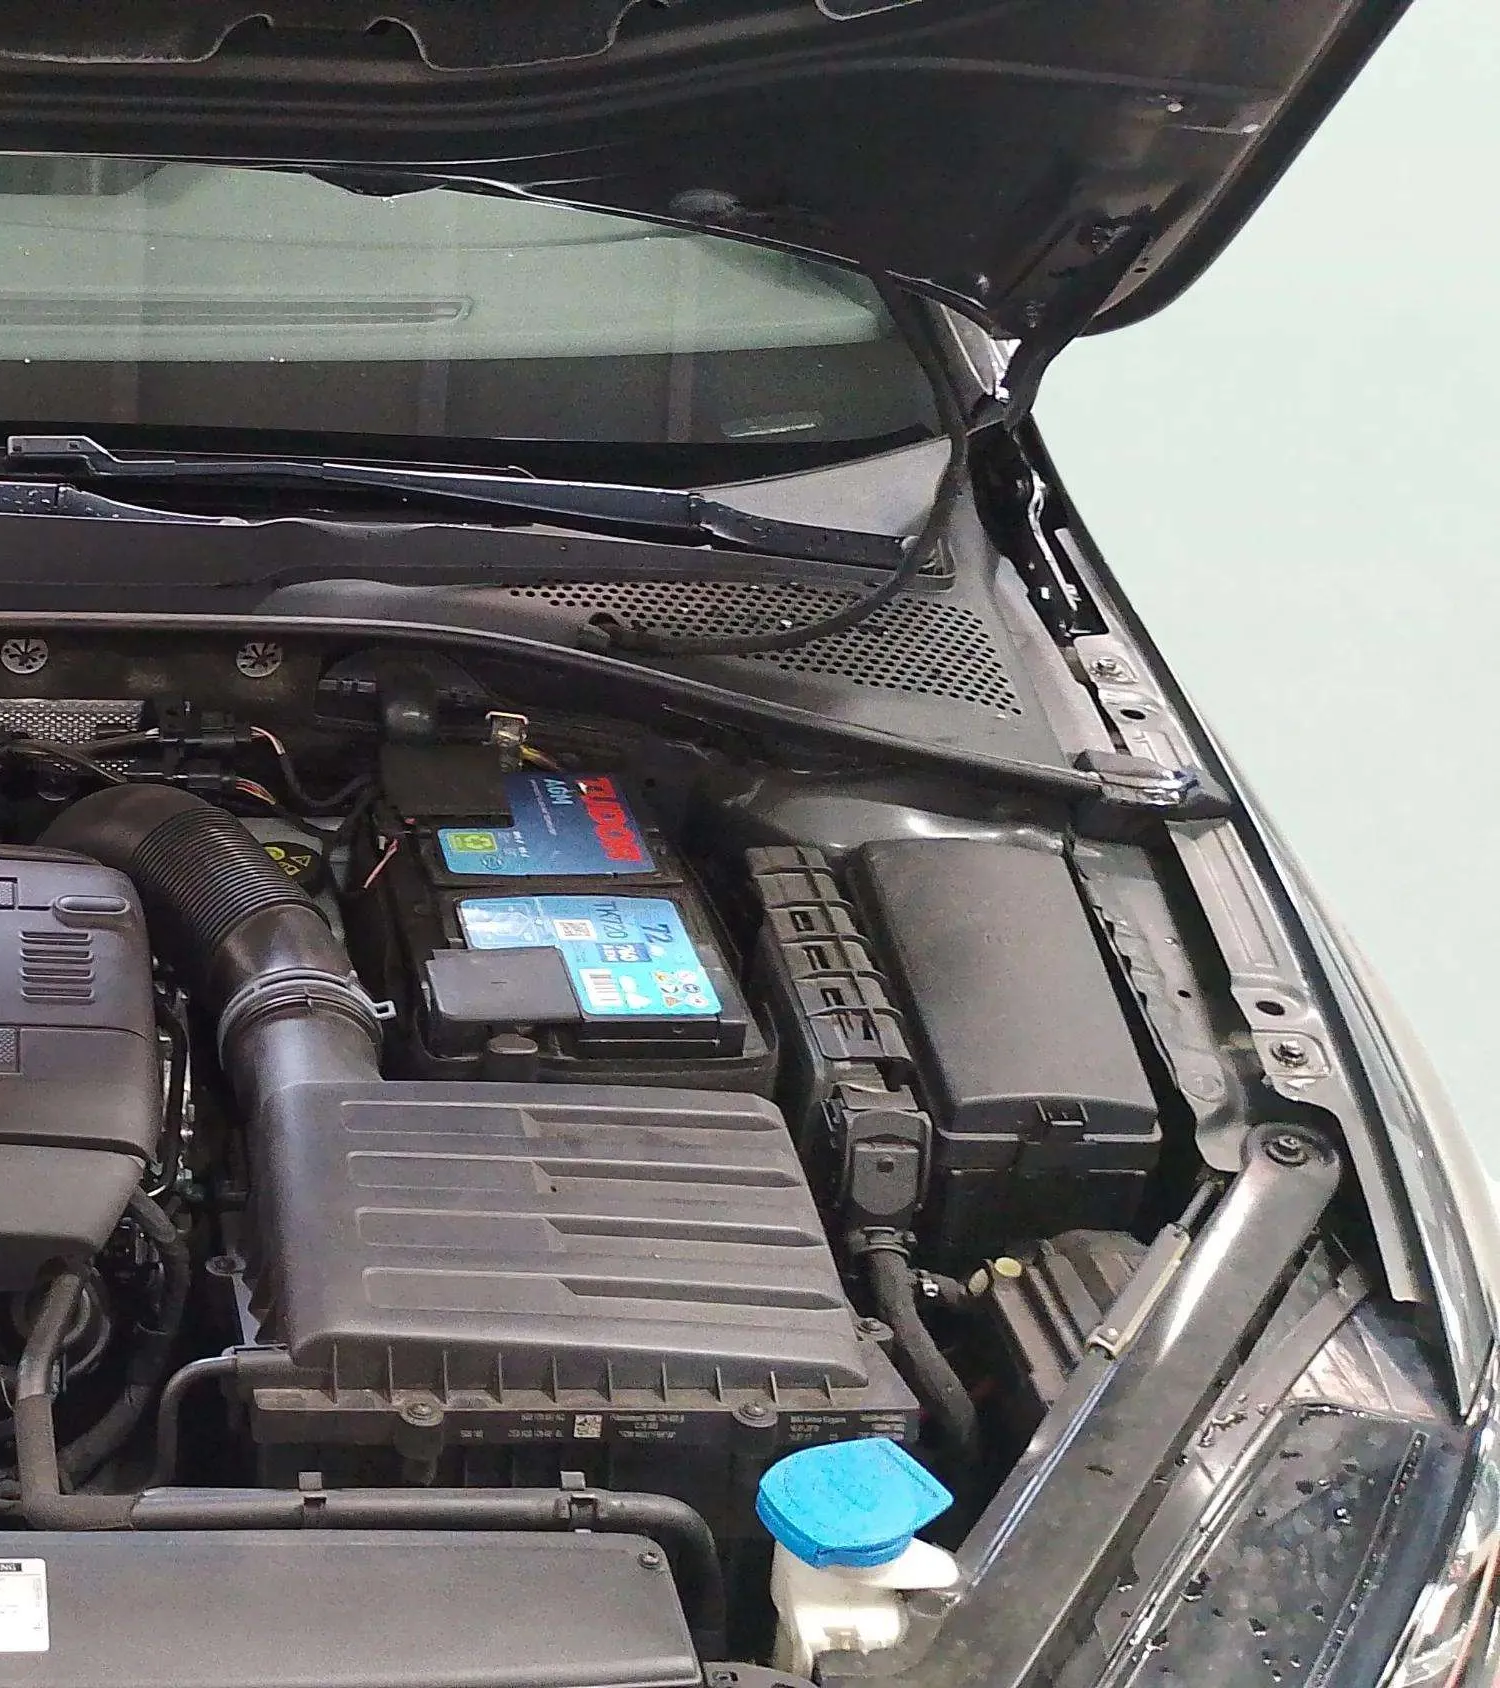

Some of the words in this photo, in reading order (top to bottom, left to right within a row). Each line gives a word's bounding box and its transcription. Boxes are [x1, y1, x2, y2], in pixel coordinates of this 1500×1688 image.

[543, 778, 573, 805] AGM
[577, 777, 641, 861] TUDOR
[593, 901, 629, 939] TK720
[640, 923, 674, 944] 72
